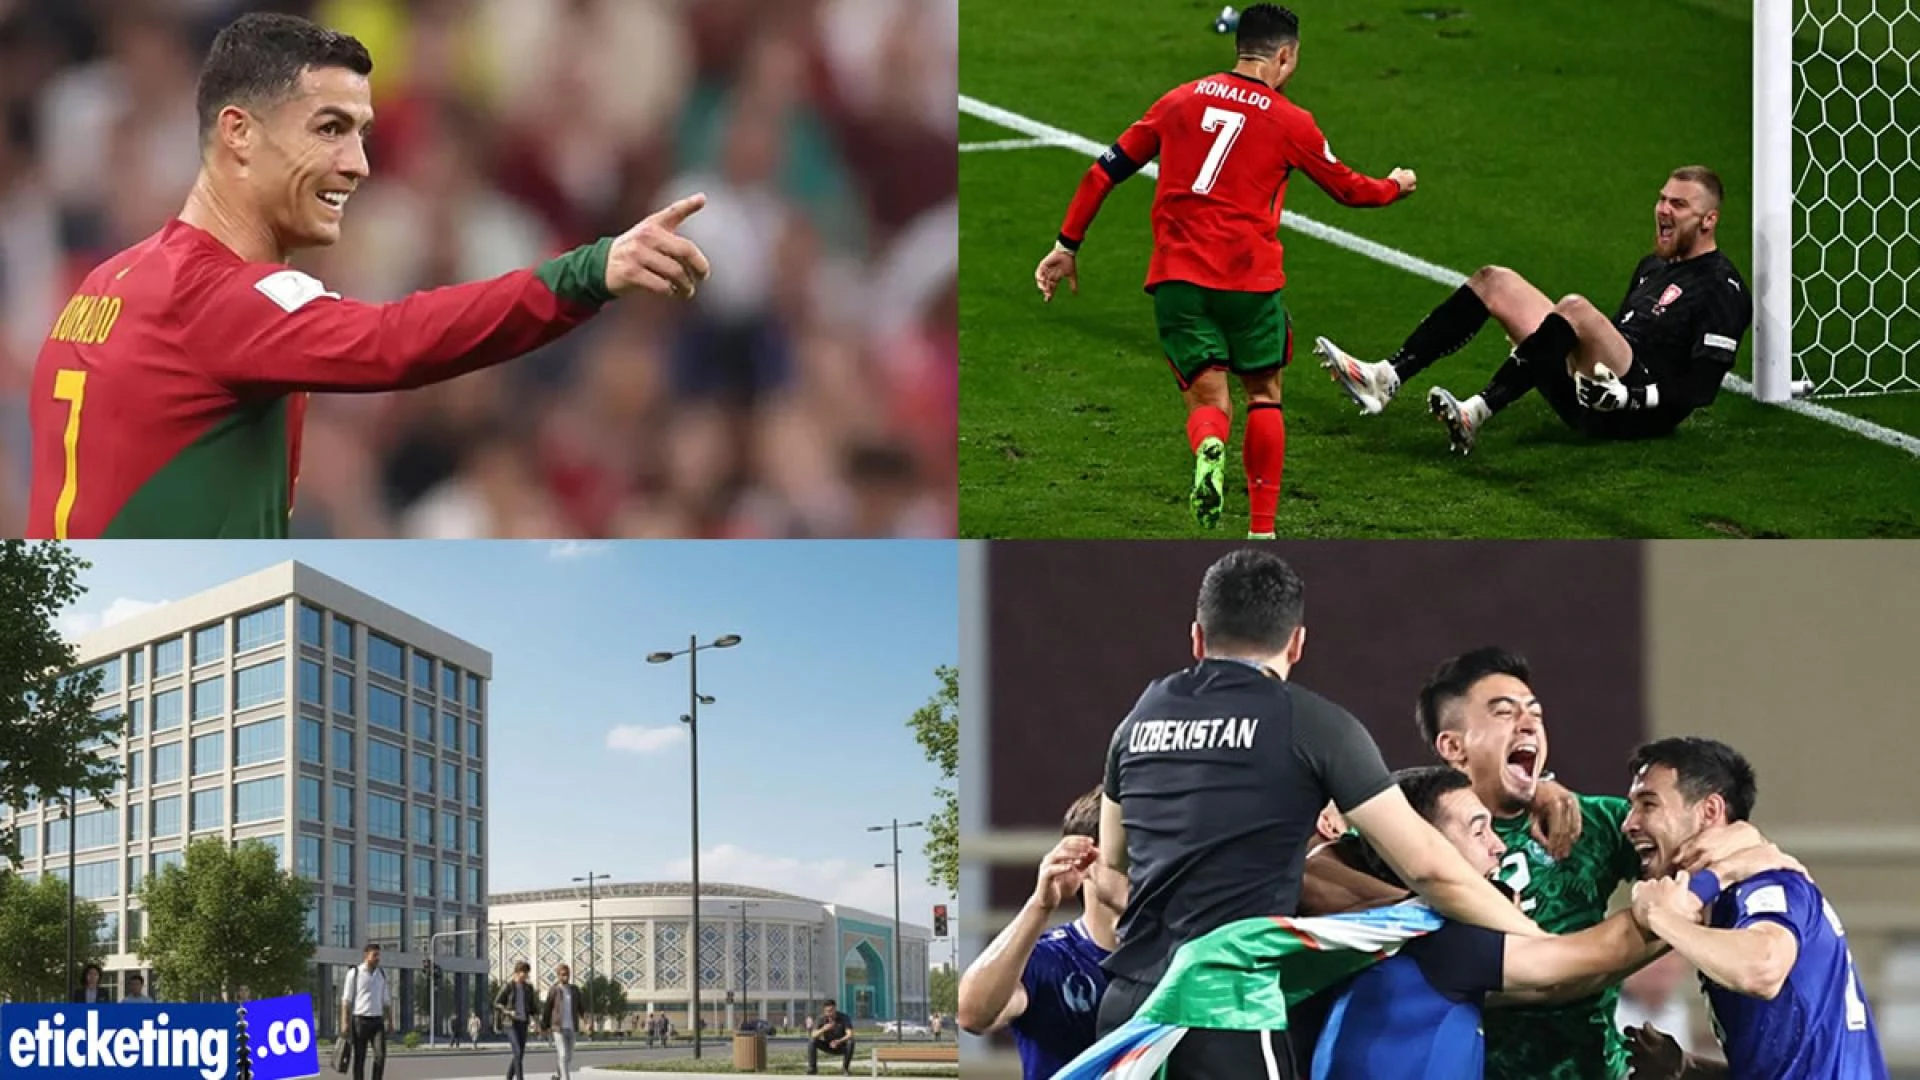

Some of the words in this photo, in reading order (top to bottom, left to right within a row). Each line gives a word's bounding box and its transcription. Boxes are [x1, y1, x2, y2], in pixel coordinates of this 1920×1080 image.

[1195, 81, 1271, 110] RONALDO
[1192, 106, 1246, 195] 7
[53, 370, 87, 539] 7
[1129, 717, 1258, 753] UZBEKISTAN
